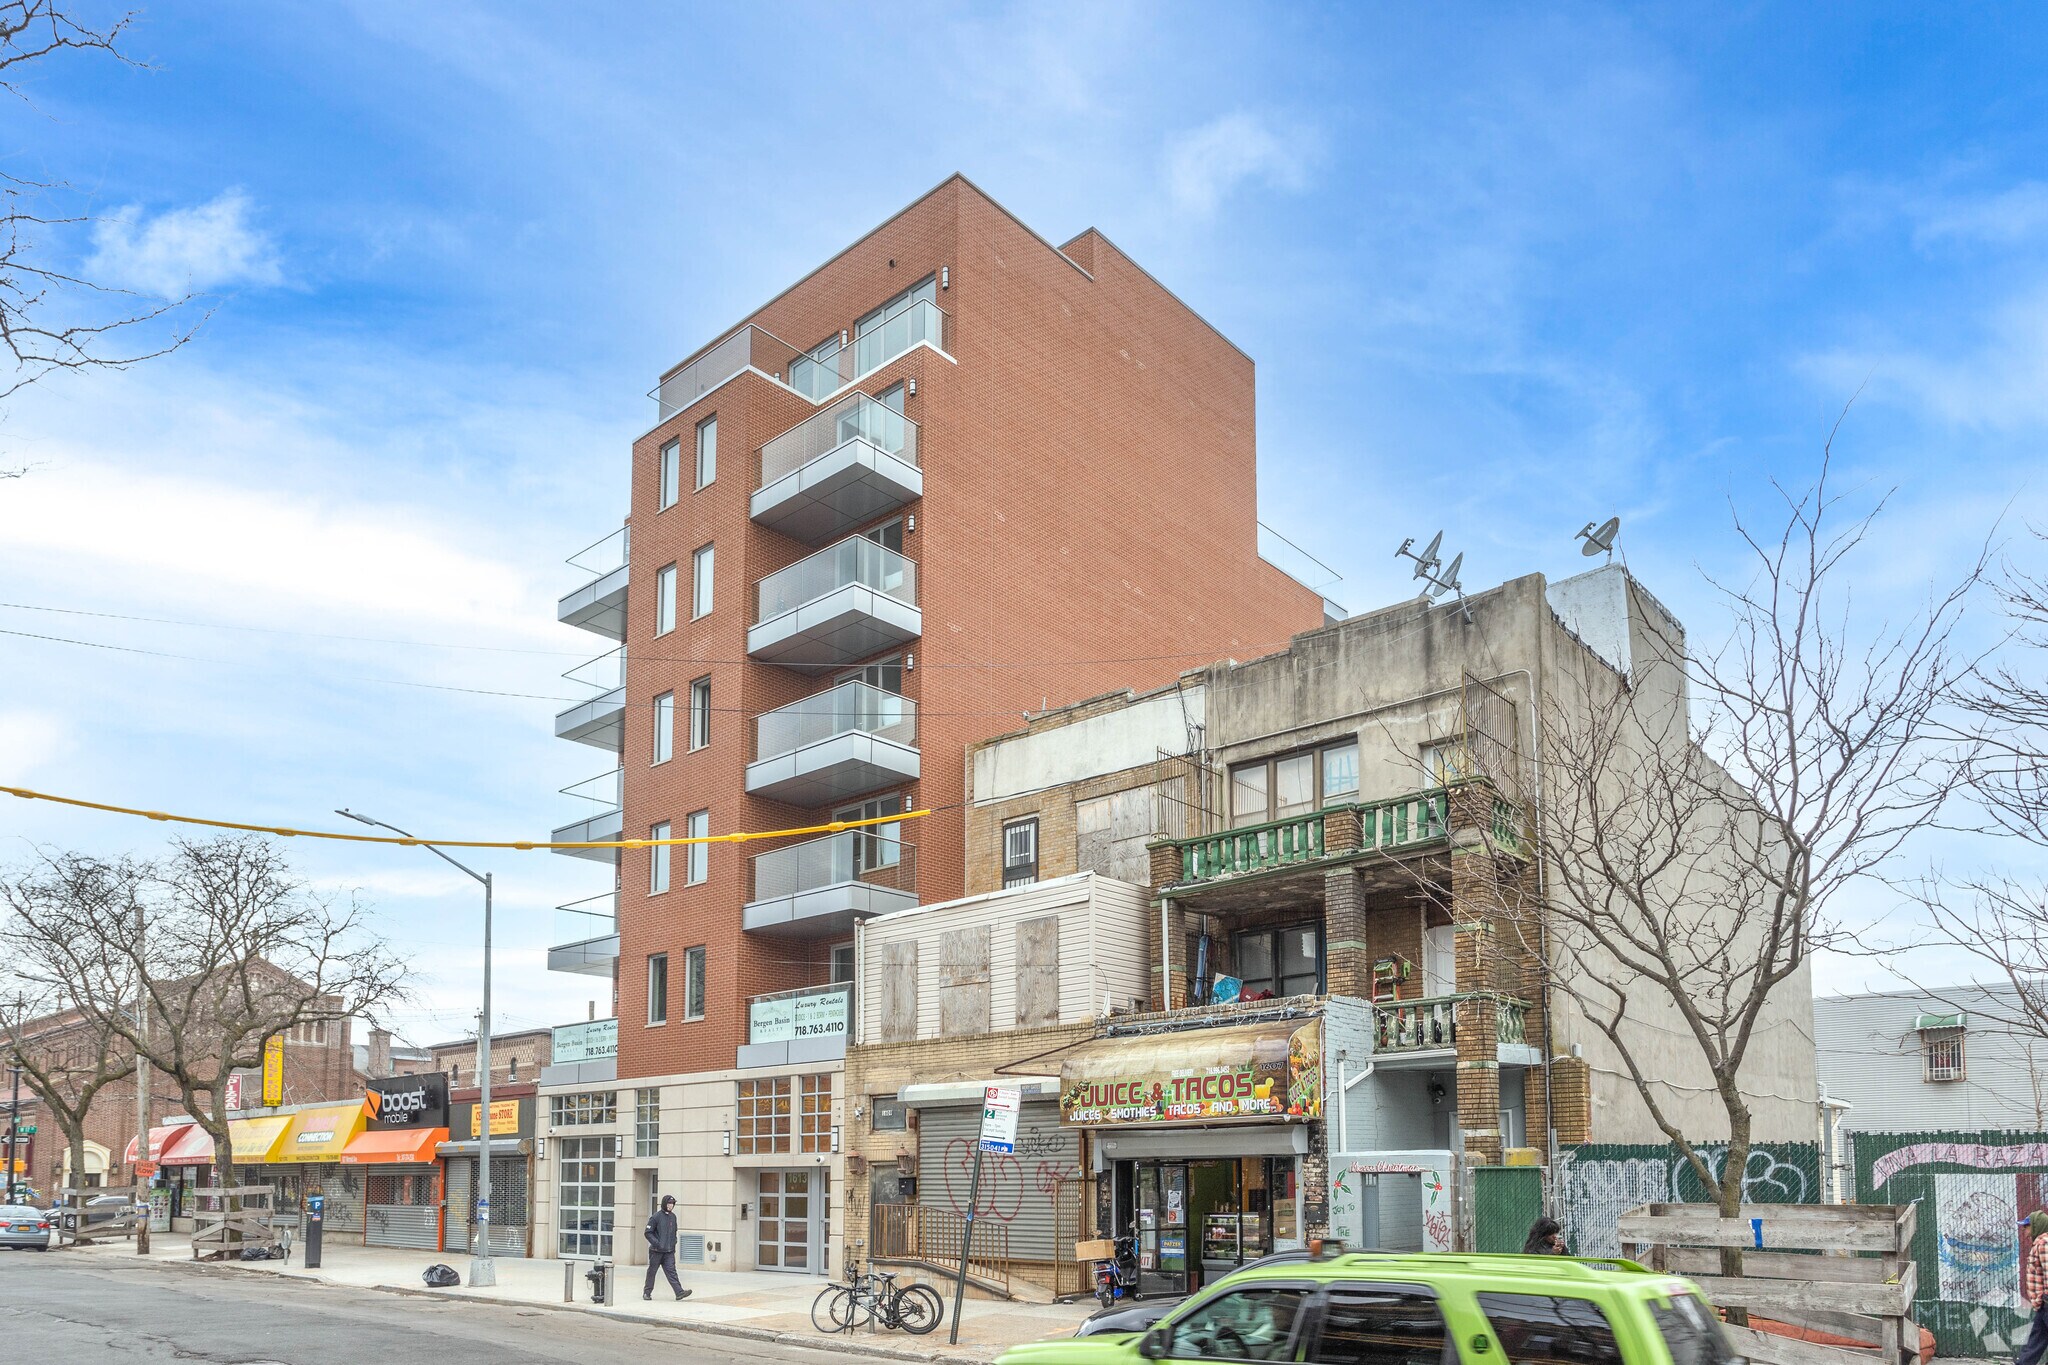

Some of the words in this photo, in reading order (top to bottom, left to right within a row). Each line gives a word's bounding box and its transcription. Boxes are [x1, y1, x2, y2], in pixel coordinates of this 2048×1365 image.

[795, 1001, 817, 1009] Luxury
[820, 997, 843, 1006] Rentals
[753, 1020, 772, 1028] Bergen
[775, 1016, 790, 1024] Basin
[794, 1021, 844, 1037] 718.763.4110
[225, 1078, 238, 1110] PIZZA
[1081, 1082, 1143, 1107] JUICE
[1151, 1082, 1164, 1101] &
[1171, 1073, 1252, 1102] TACOS
[381, 1085, 427, 1113] boost
[384, 1111, 408, 1124] mobile
[498, 1108, 513, 1120] STORE
[986, 1110, 994, 1119] 2
[1069, 1109, 1101, 1121] JUICES
[1111, 1106, 1157, 1118] SMOTHIES
[1168, 1103, 1201, 1116] TACOS
[297, 1131, 334, 1143] CONNECTION
[1874, 1146, 1918, 1178] VIVA
[1931, 1144, 1958, 1162] LA
[1974, 1143, 2044, 1168] RAZA
[788, 1173, 808, 1184] 1613
[1332, 1204, 1345, 1215] JOY
[1347, 1202, 1356, 1211] TO
[1336, 1225, 1350, 1237] THE
